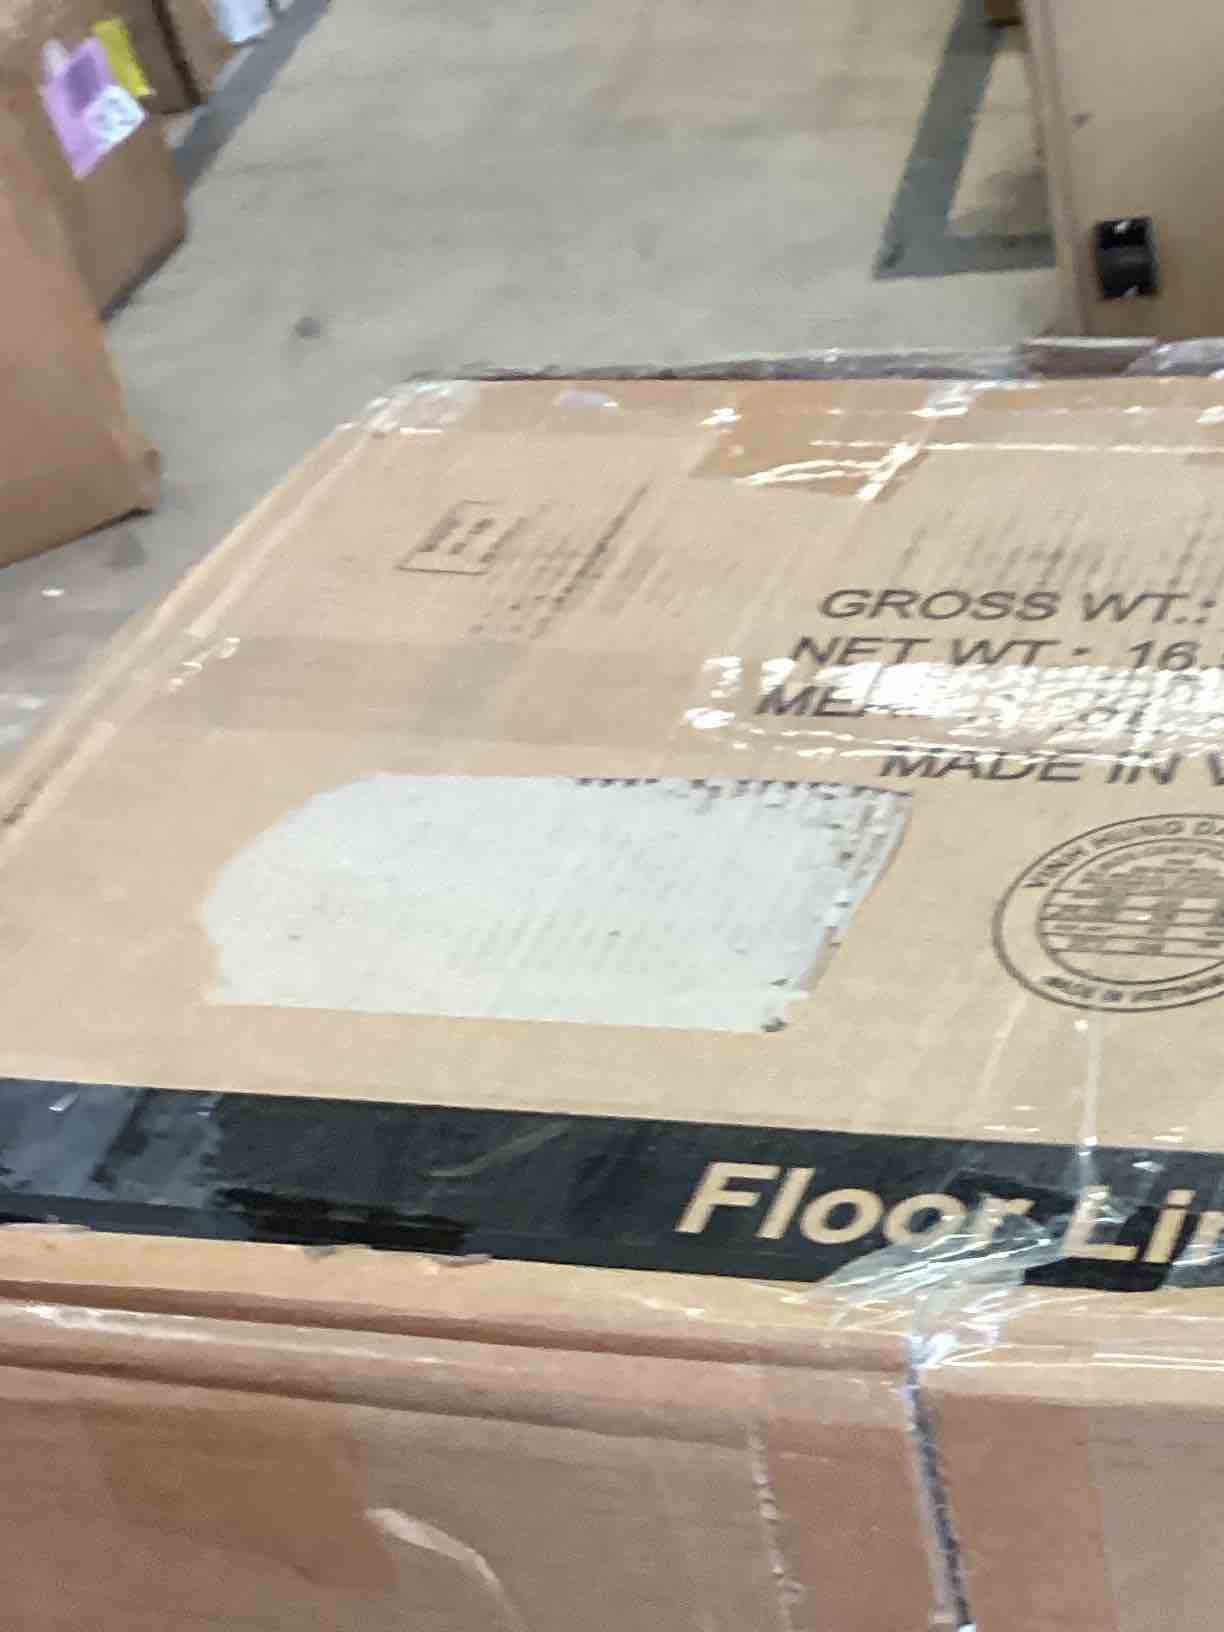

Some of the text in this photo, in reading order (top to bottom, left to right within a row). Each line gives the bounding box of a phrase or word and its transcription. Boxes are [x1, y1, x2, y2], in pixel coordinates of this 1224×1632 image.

[820, 588, 1062, 621] GROSS
[791, 636, 931, 667] NET
[879, 746, 1086, 783] MADE
[1105, 751, 1177, 785] IN
[673, 1160, 1037, 1250] Floor
